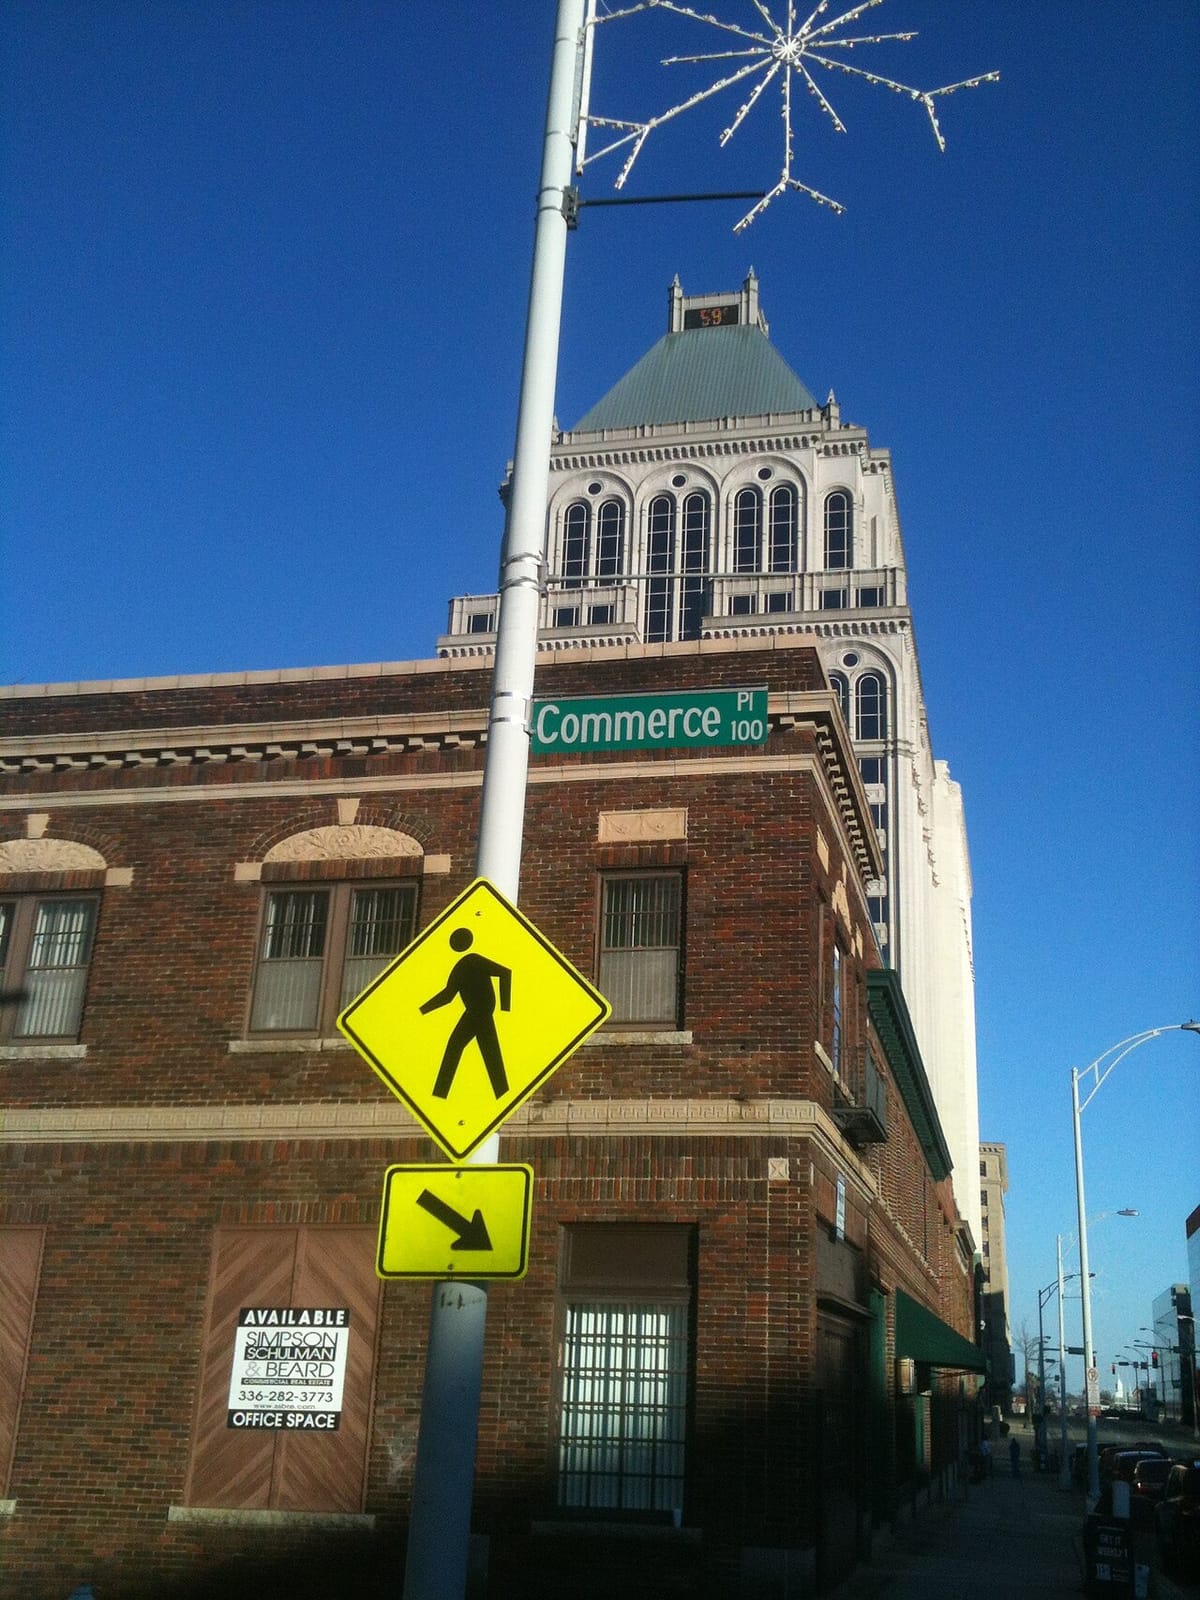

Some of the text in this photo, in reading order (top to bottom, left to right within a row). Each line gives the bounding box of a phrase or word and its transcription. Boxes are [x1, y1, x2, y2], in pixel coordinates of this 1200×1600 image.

[737, 691, 753, 712] Pl
[536, 704, 721, 744] Commerce
[730, 719, 764, 742] 100
[243, 1309, 345, 1325] AVAILABLE
[245, 1331, 339, 1347] SIMPSON
[246, 1346, 334, 1360] SCHULMAN
[245, 1361, 335, 1378] & BEARD
[238, 1390, 334, 1403] 336-282-3773
[232, 1412, 336, 1428] OFFICE SPACE
